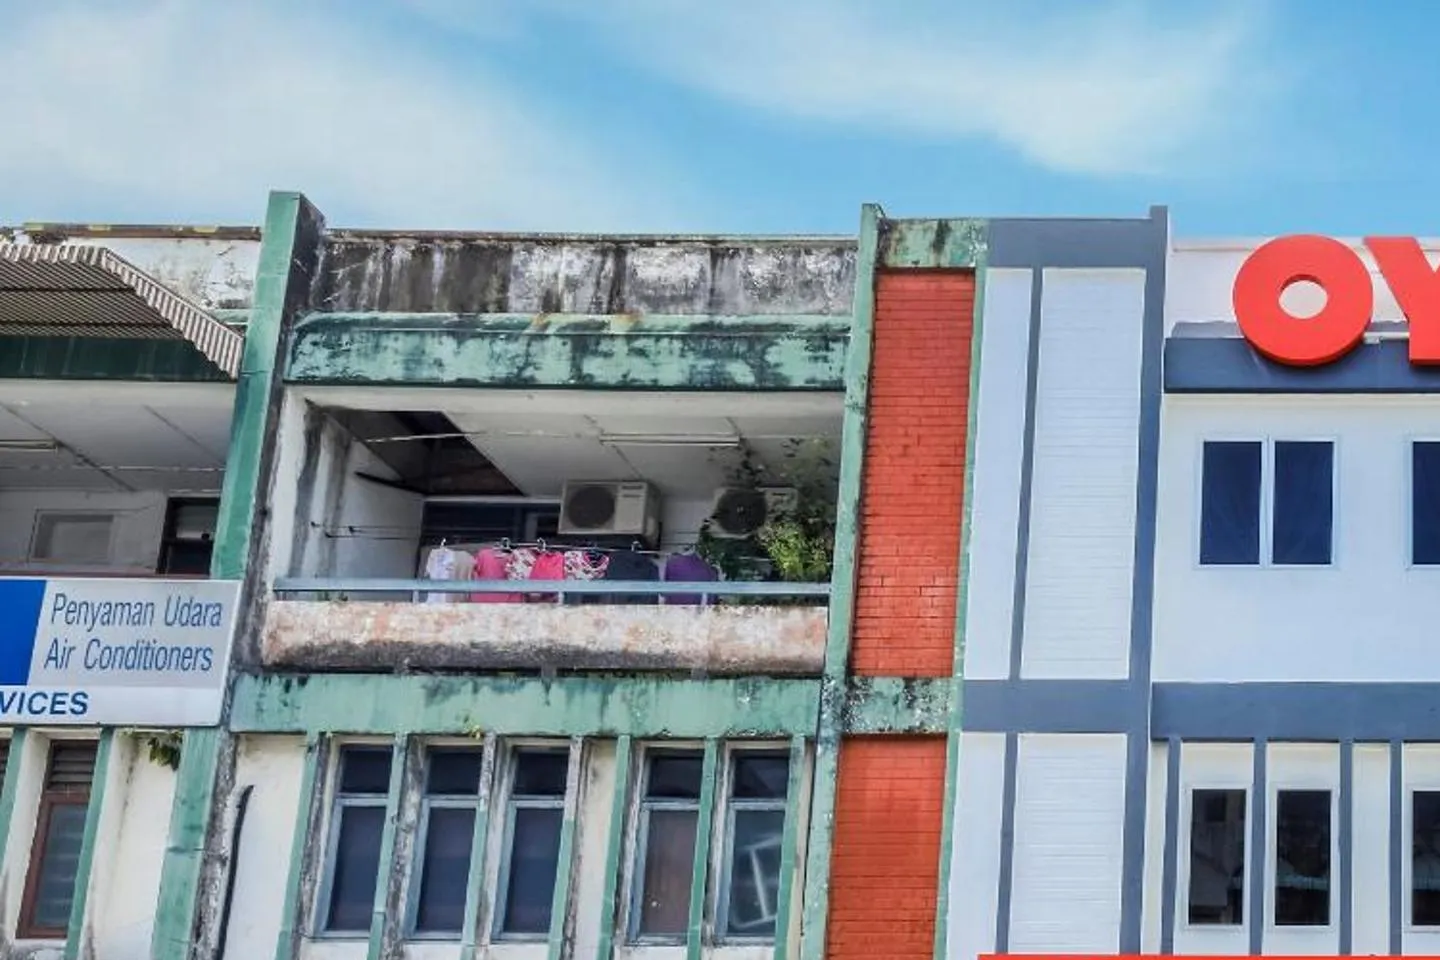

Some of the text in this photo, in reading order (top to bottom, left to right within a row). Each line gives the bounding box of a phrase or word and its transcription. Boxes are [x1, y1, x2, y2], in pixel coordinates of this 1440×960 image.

[51, 593, 223, 632] Penyaman Udara
[44, 637, 213, 671] Air Conditioners
[0, 691, 89, 715] VICES
